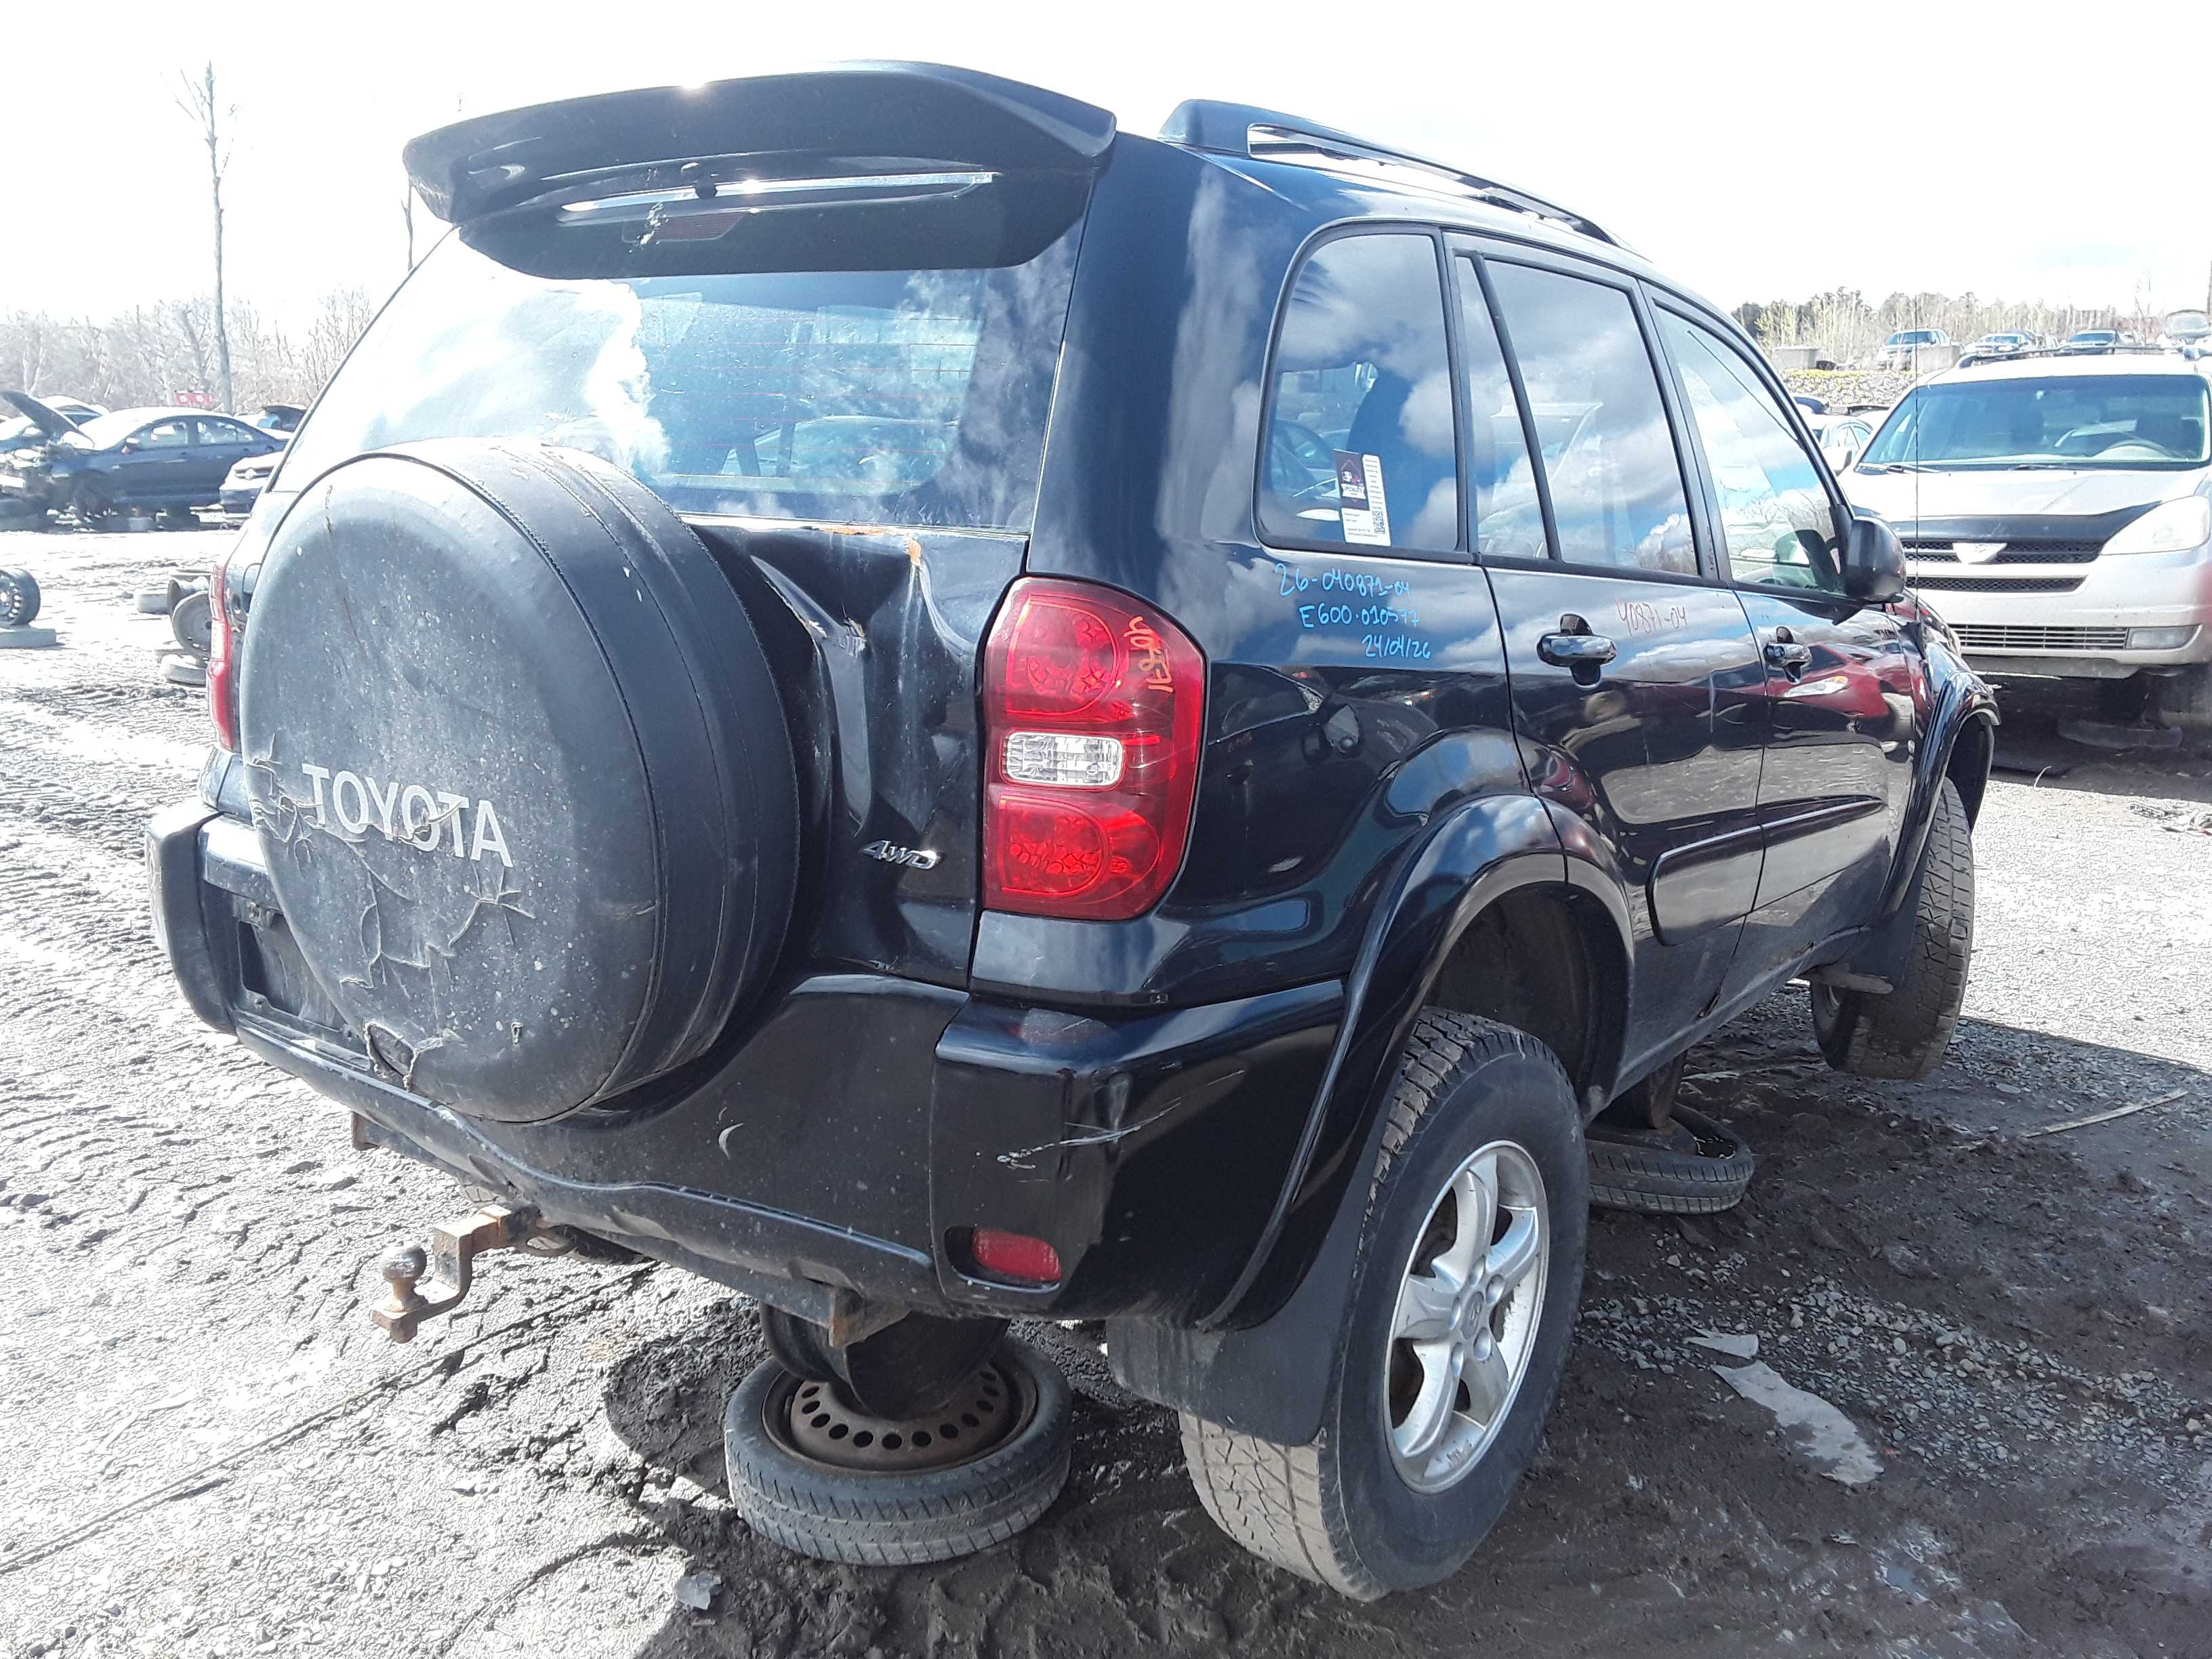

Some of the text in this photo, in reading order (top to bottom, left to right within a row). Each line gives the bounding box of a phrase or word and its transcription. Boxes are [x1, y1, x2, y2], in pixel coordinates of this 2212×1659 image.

[1362, 634, 1431, 659] 24/04/26
[302, 763, 514, 868] TOYOTA
[863, 840, 941, 869] 4WD
